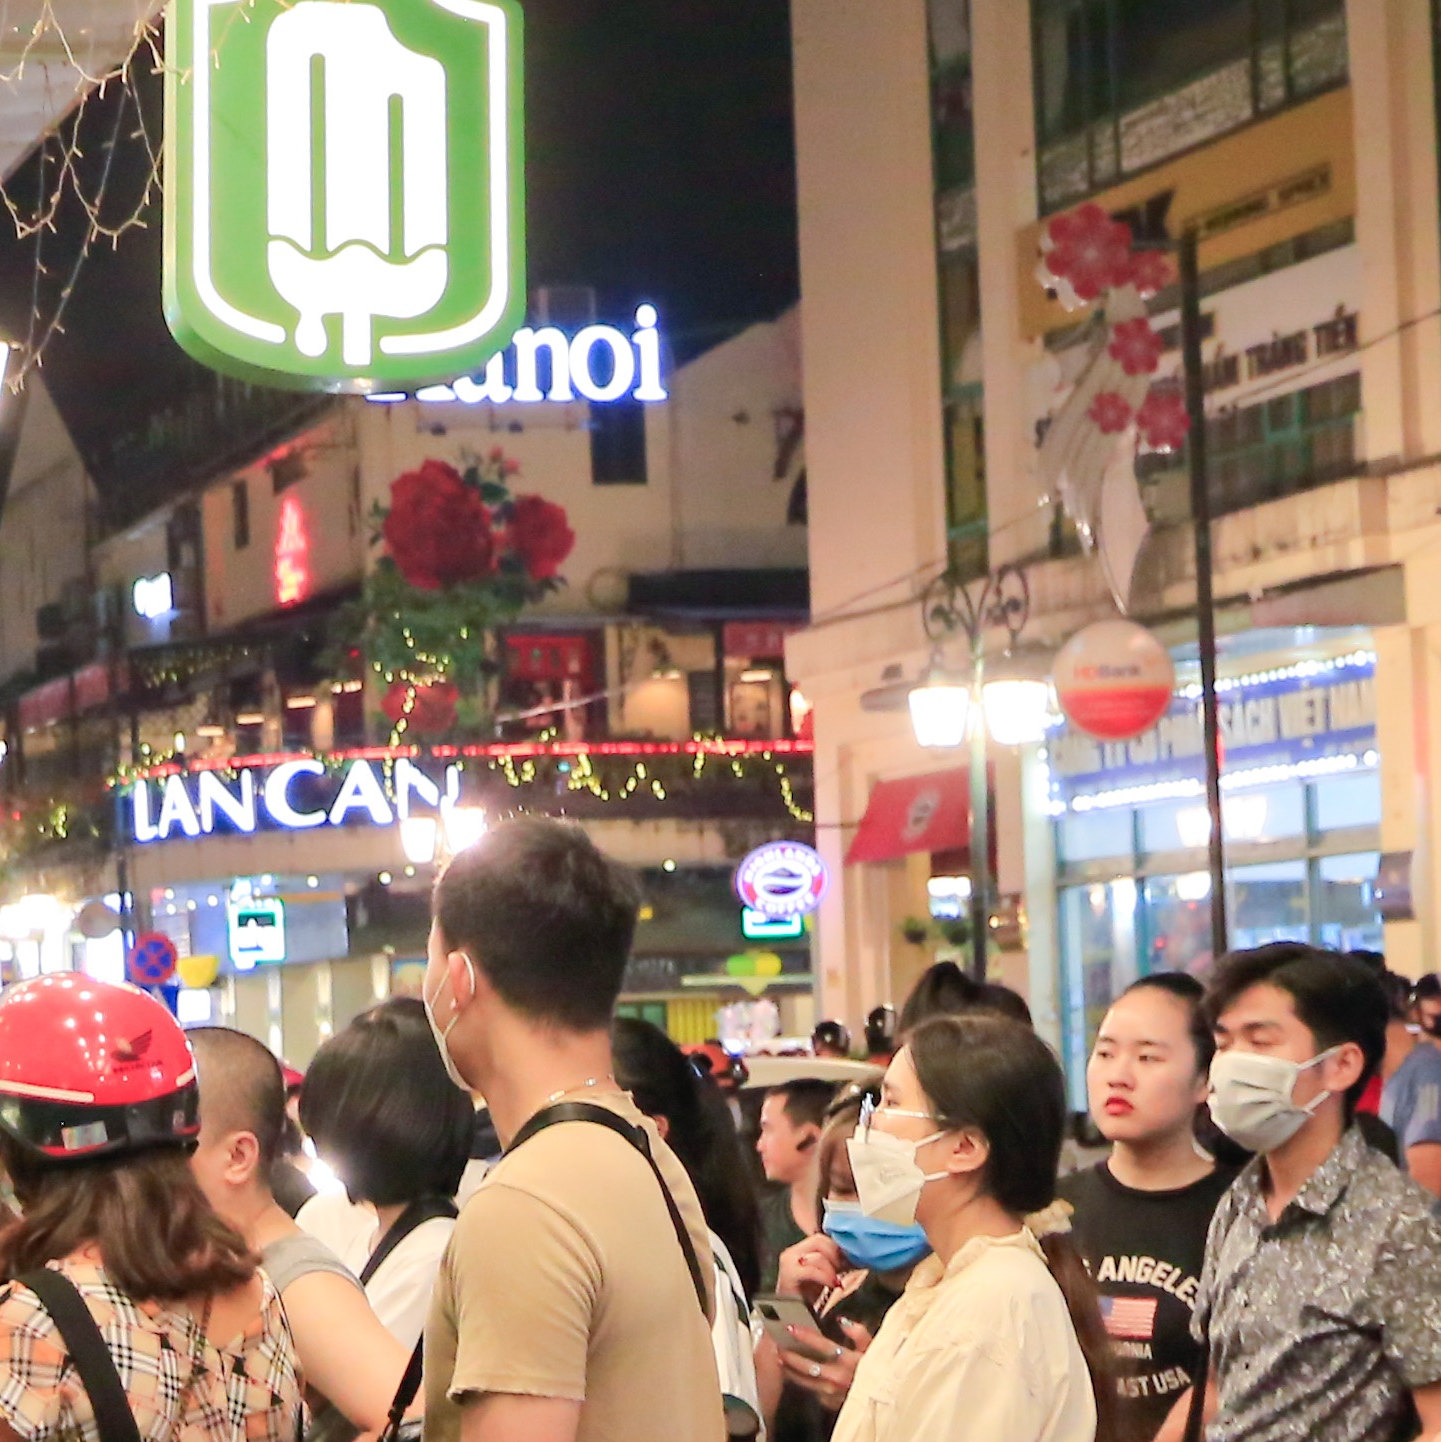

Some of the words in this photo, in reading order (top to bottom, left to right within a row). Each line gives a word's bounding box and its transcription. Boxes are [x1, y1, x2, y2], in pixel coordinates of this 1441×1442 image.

[133, 769, 256, 842] LAN
[264, 758, 460, 828] CAN
[1097, 1255, 1200, 1311] ANGELE
[1116, 1375, 1149, 1398] AST
[1151, 1366, 1192, 1394] USA
